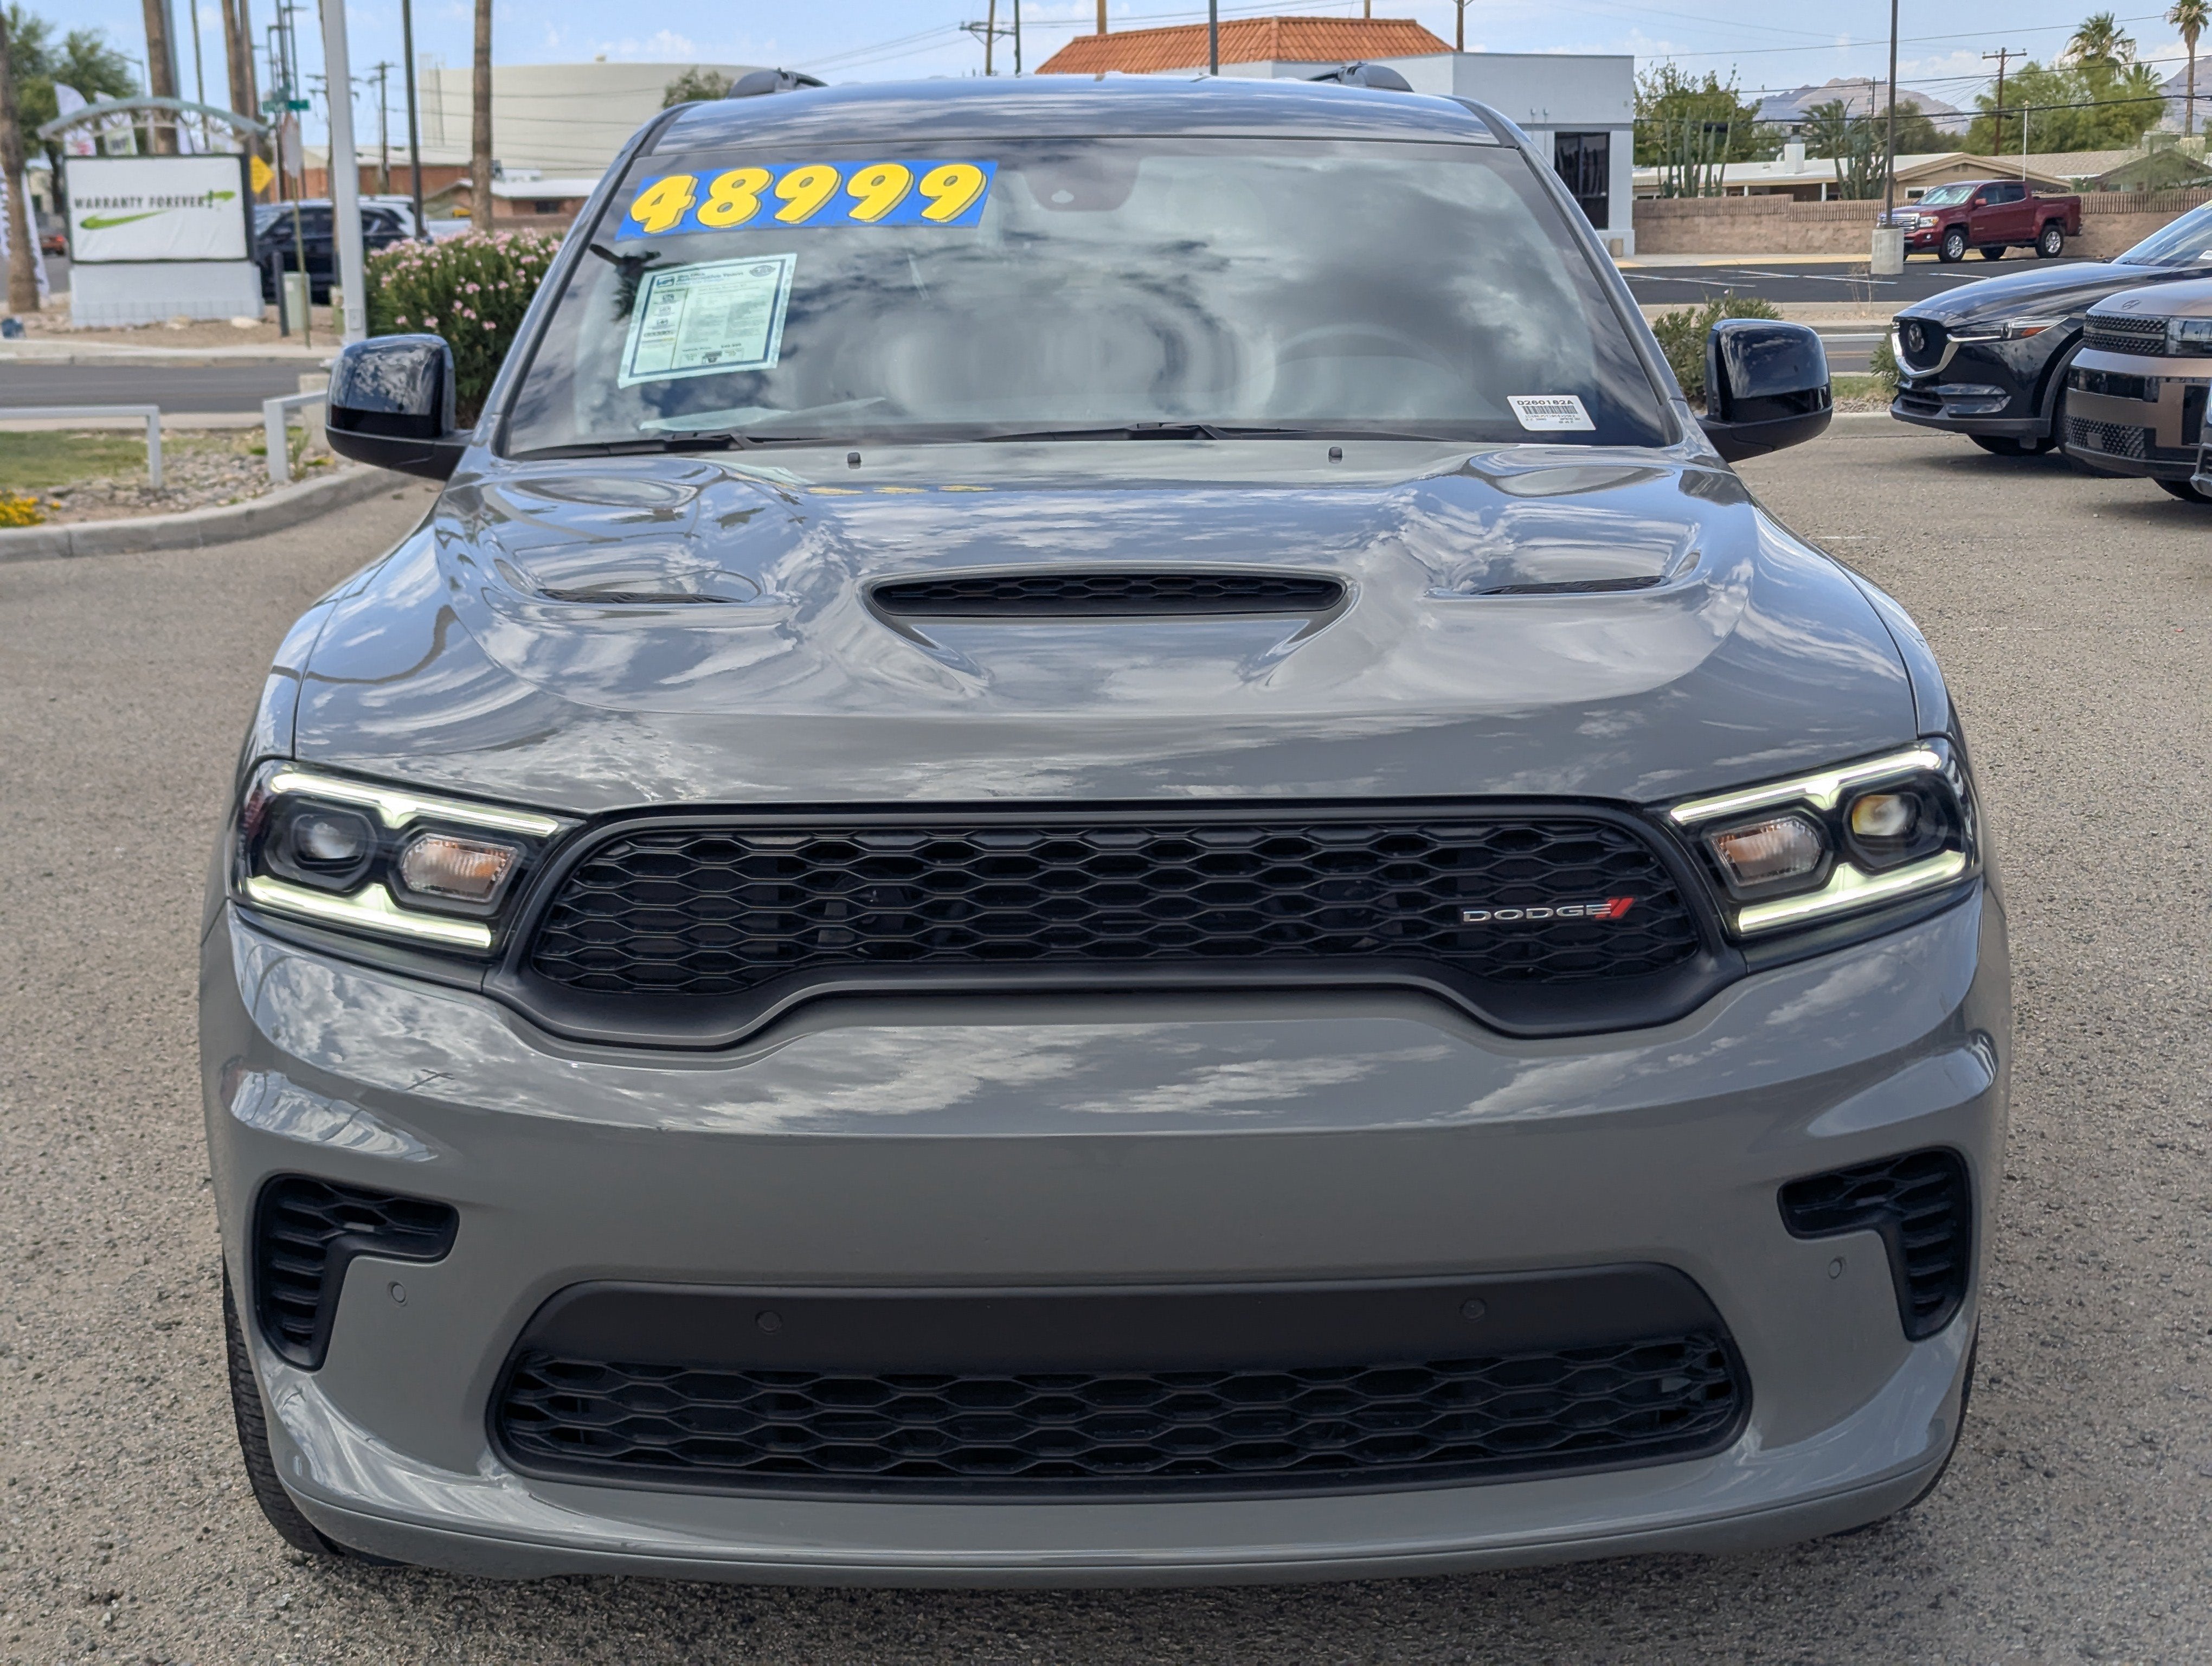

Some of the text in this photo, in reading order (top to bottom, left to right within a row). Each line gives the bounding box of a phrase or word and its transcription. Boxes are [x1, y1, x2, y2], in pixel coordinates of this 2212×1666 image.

[74, 195, 142, 209] WARRANTY
[631, 164, 986, 233] 48999
[1463, 904, 1611, 921] DODGE
